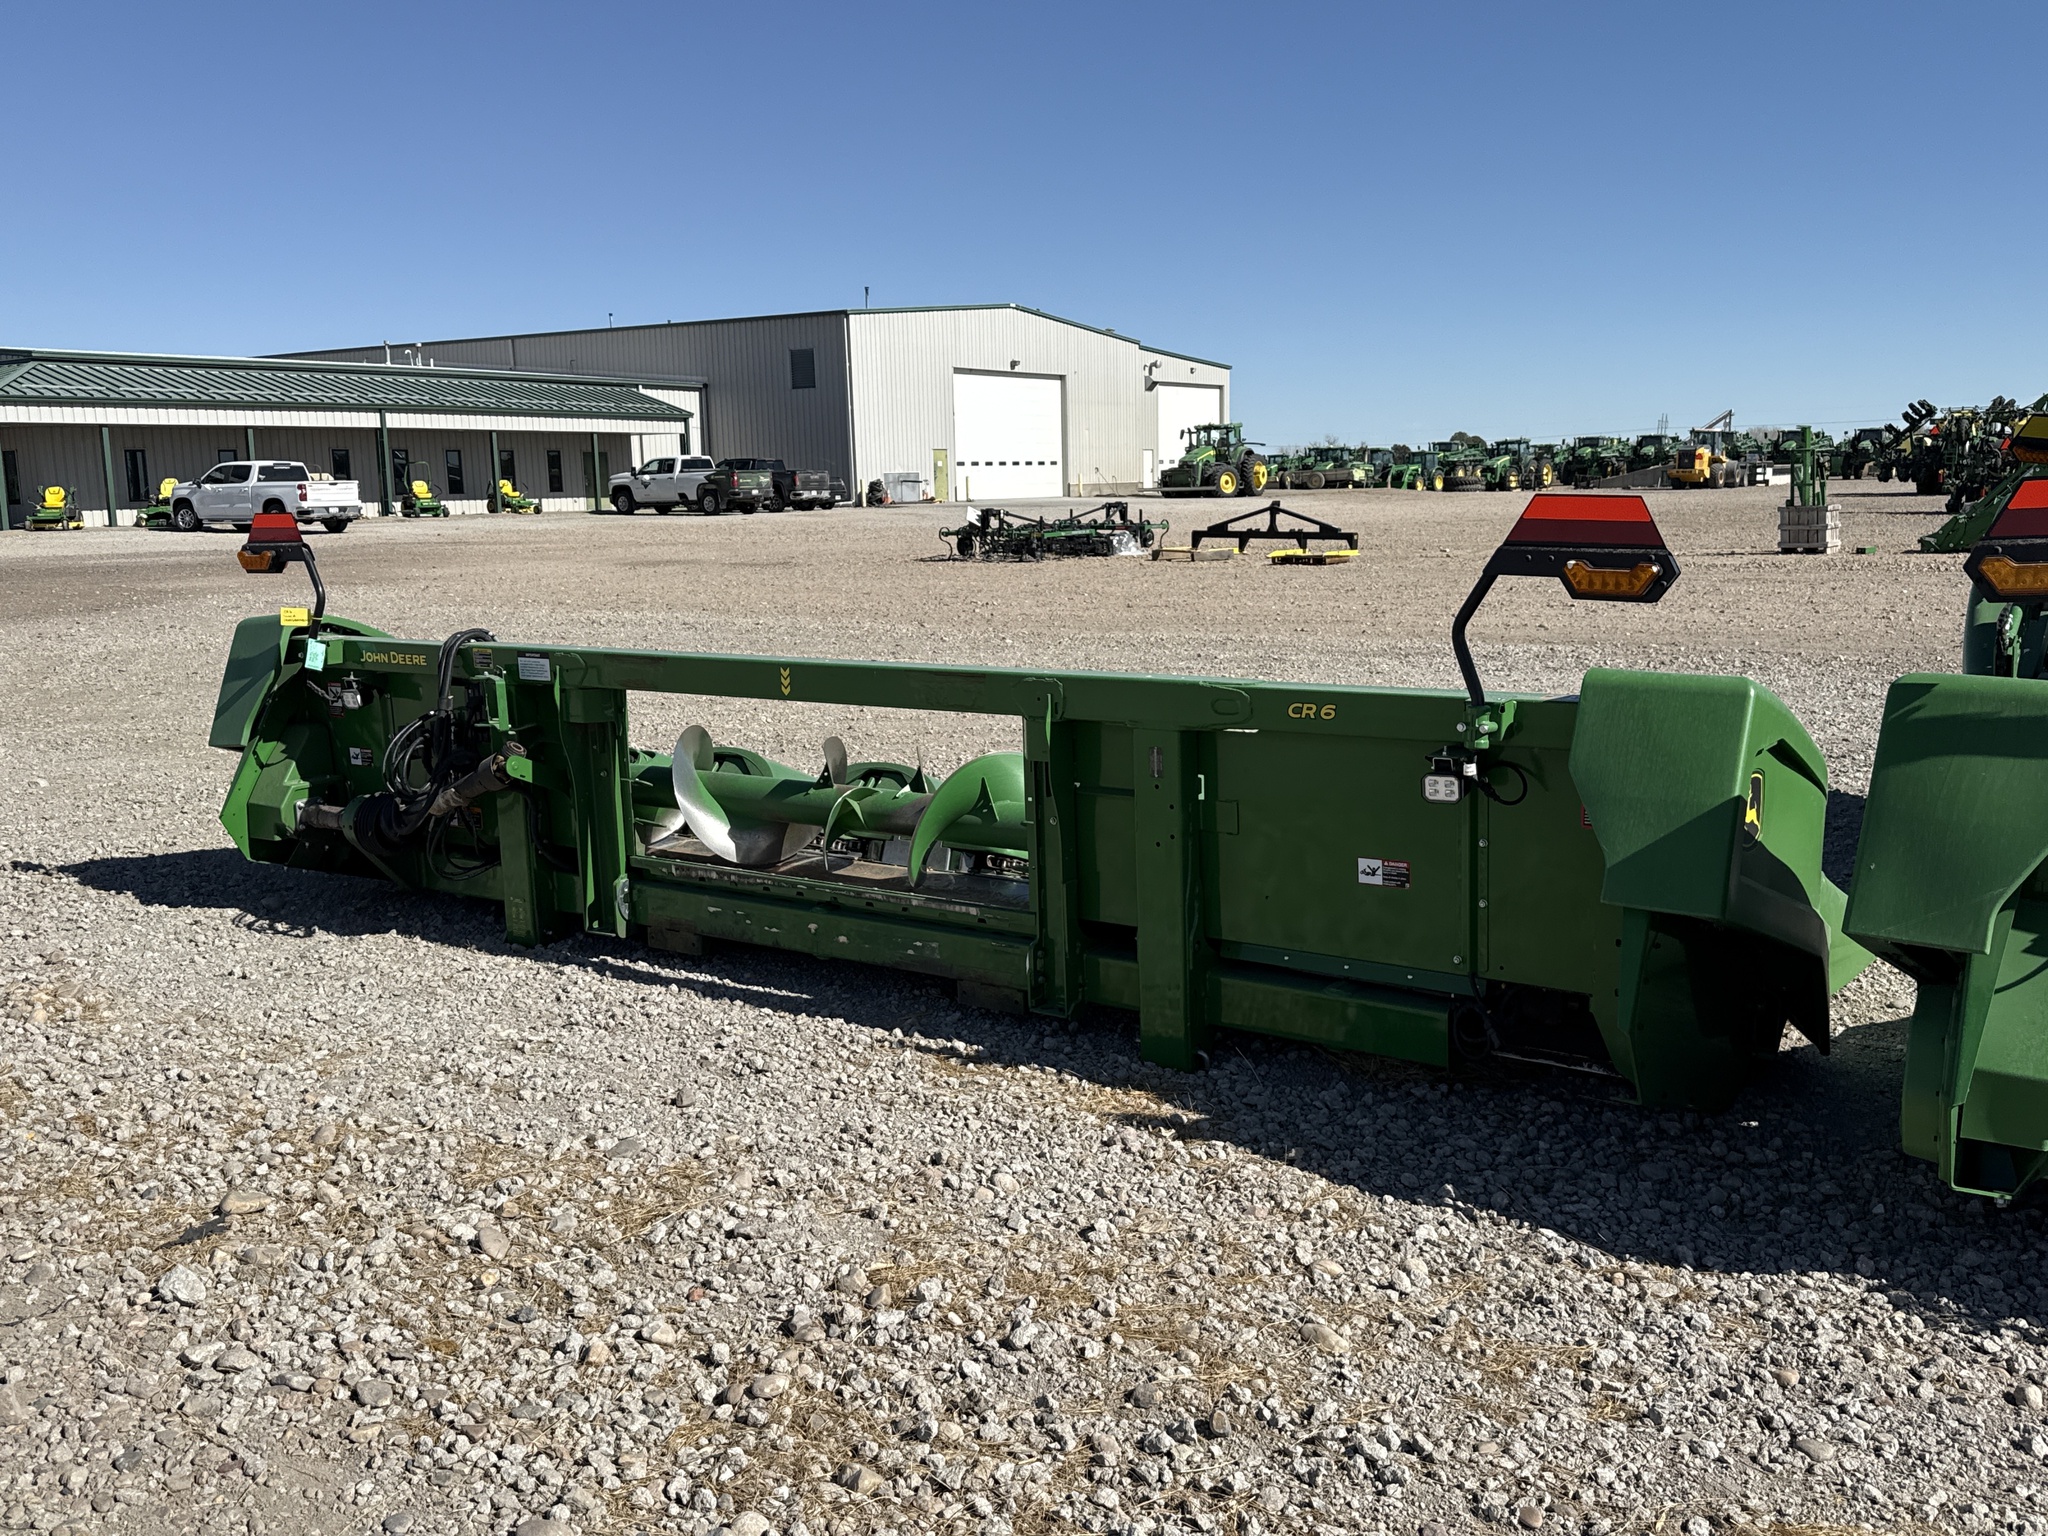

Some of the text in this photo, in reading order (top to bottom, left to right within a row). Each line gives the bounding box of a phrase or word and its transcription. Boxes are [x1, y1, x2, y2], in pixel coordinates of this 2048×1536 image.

[360, 650, 427, 666] JOHN DEERE
[1287, 702, 1336, 720] CR 6
